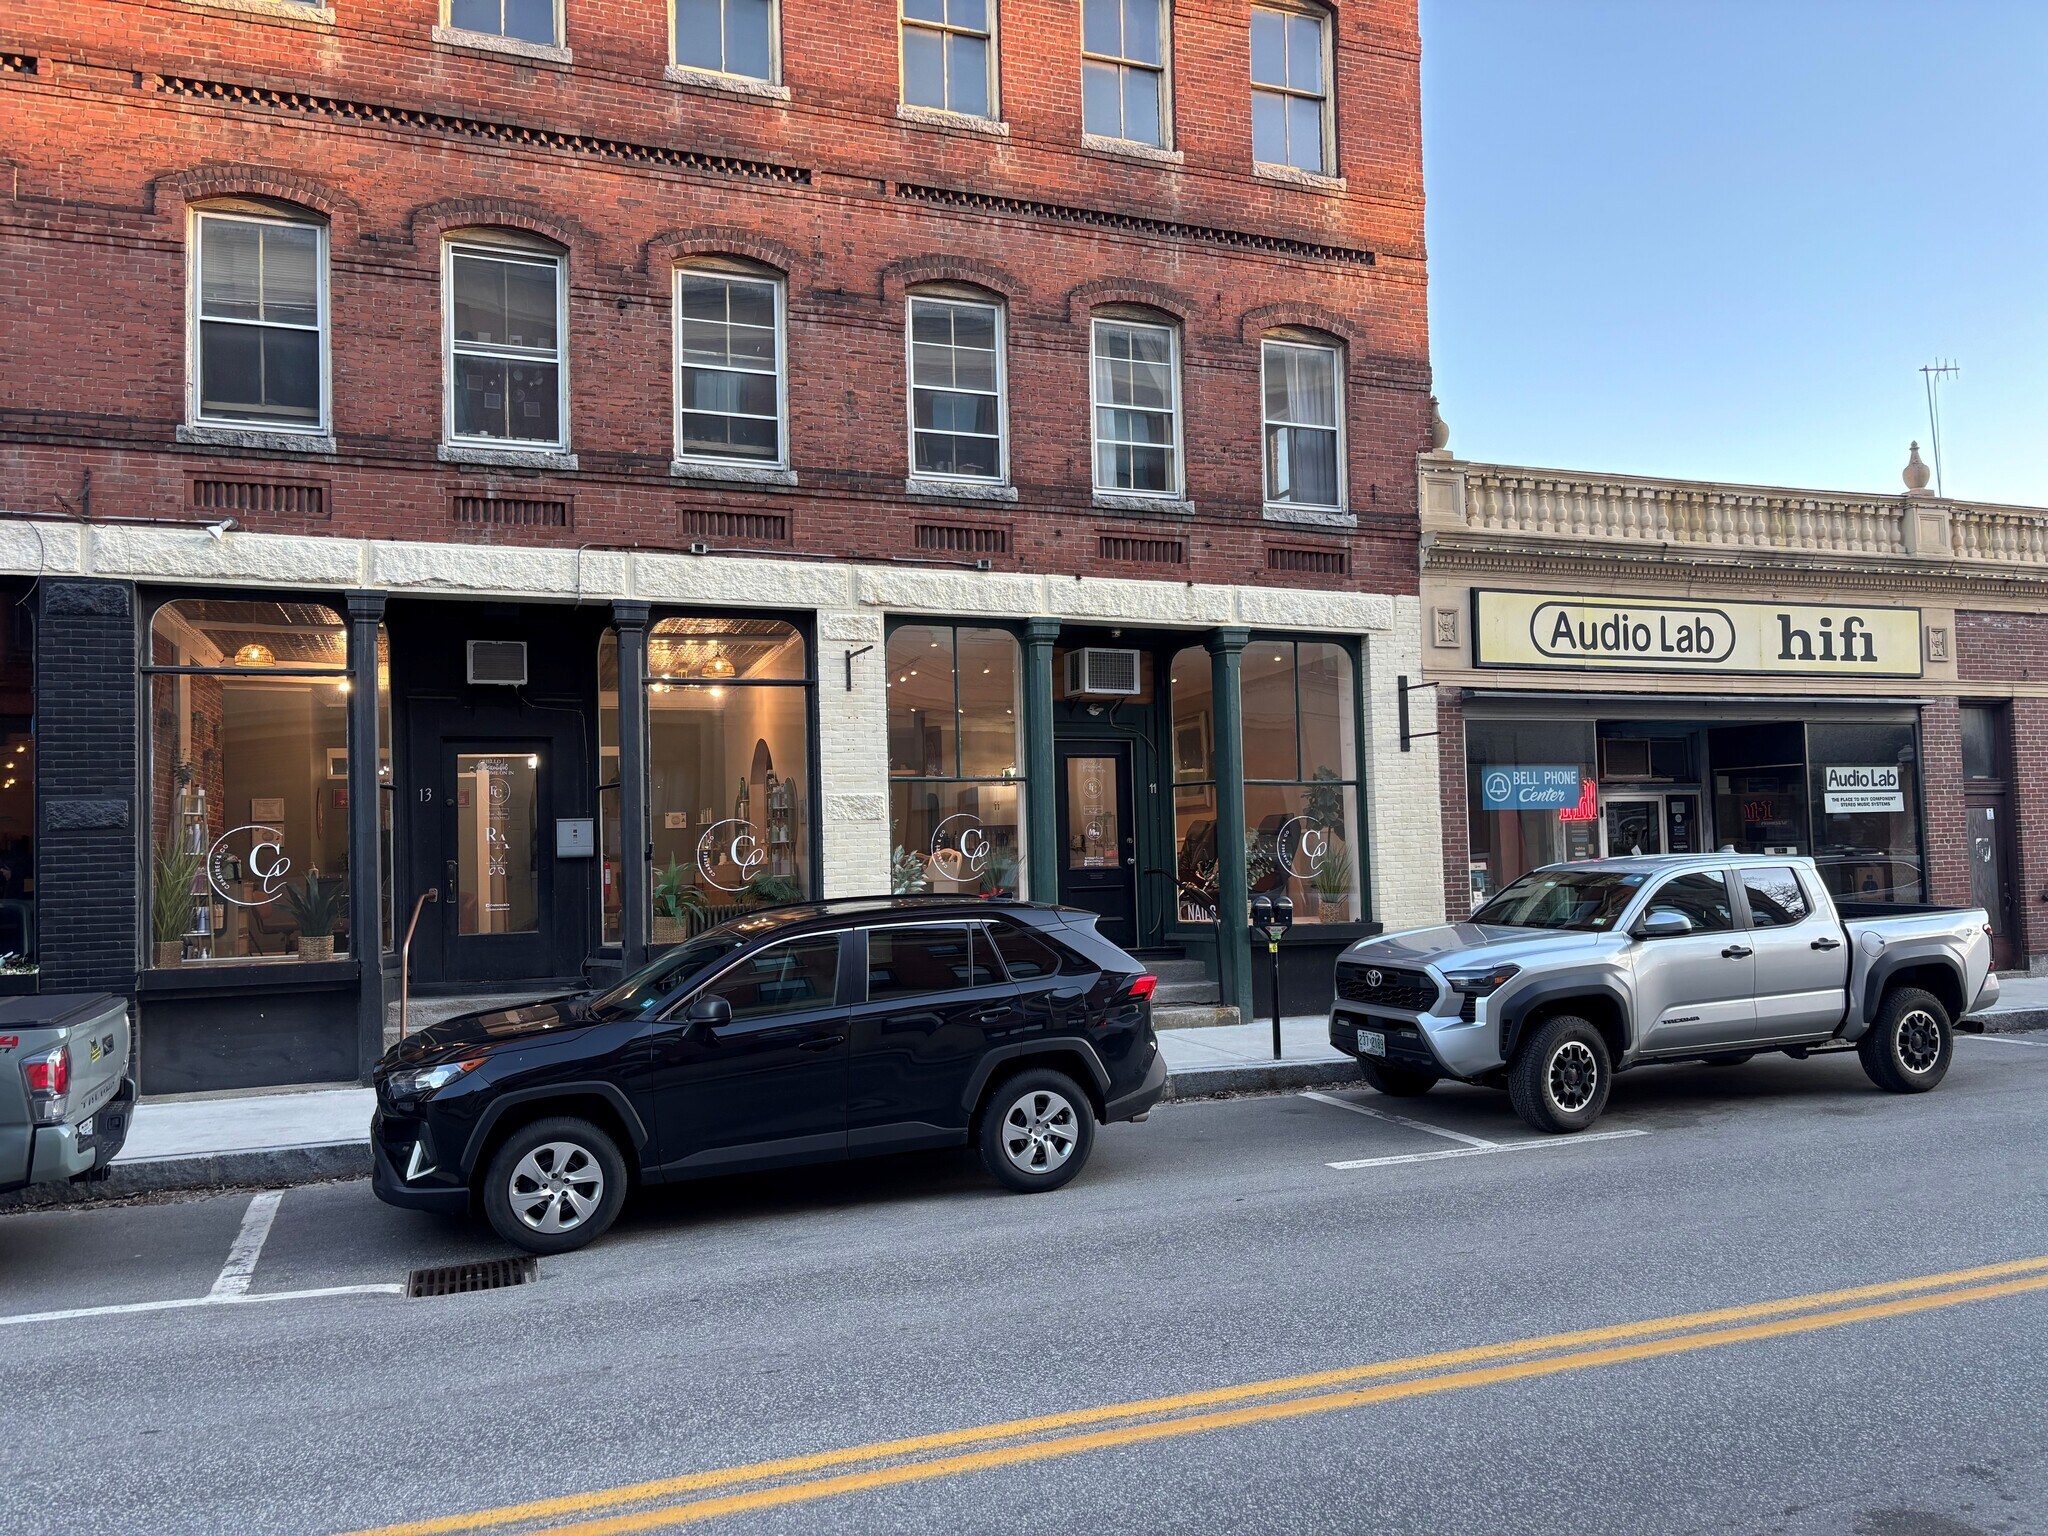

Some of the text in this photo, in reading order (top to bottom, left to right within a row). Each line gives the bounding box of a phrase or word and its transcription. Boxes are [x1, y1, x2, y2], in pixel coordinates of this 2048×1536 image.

[1550, 611, 1715, 654] Audio Lab
[1776, 613, 1878, 662] hifi
[1513, 771, 1577, 785] BELL PHONE
[1828, 768, 1897, 787] Audio Lab
[419, 788, 432, 802] 13
[1149, 782, 1157, 794] 11
[1518, 785, 1566, 803] Center
